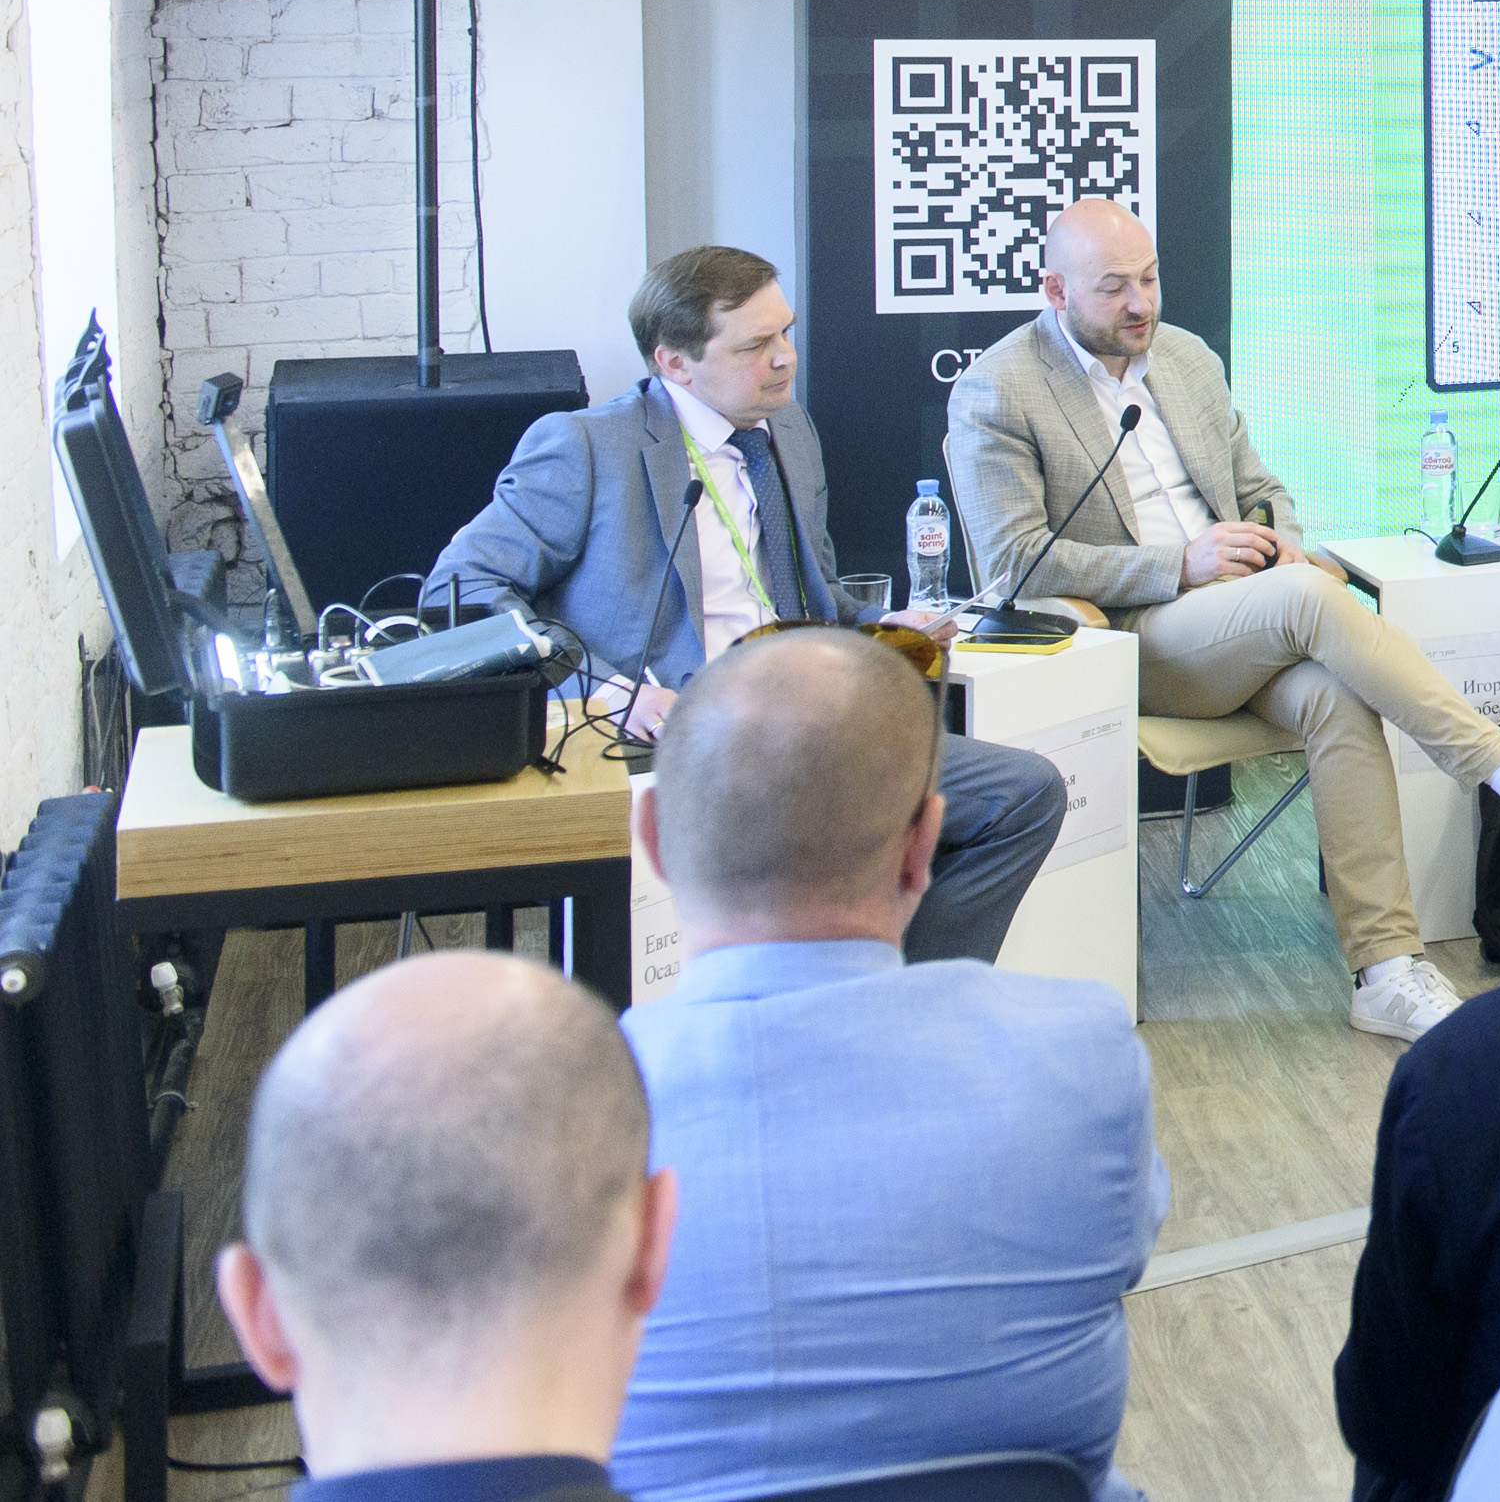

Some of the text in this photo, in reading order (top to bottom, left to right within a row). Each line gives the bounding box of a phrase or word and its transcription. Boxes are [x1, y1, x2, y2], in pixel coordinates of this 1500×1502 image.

[1451, 340, 1460, 354] 5
[920, 532, 943, 540] saint
[917, 538, 946, 550] spring
[644, 930, 679, 956] Евге
